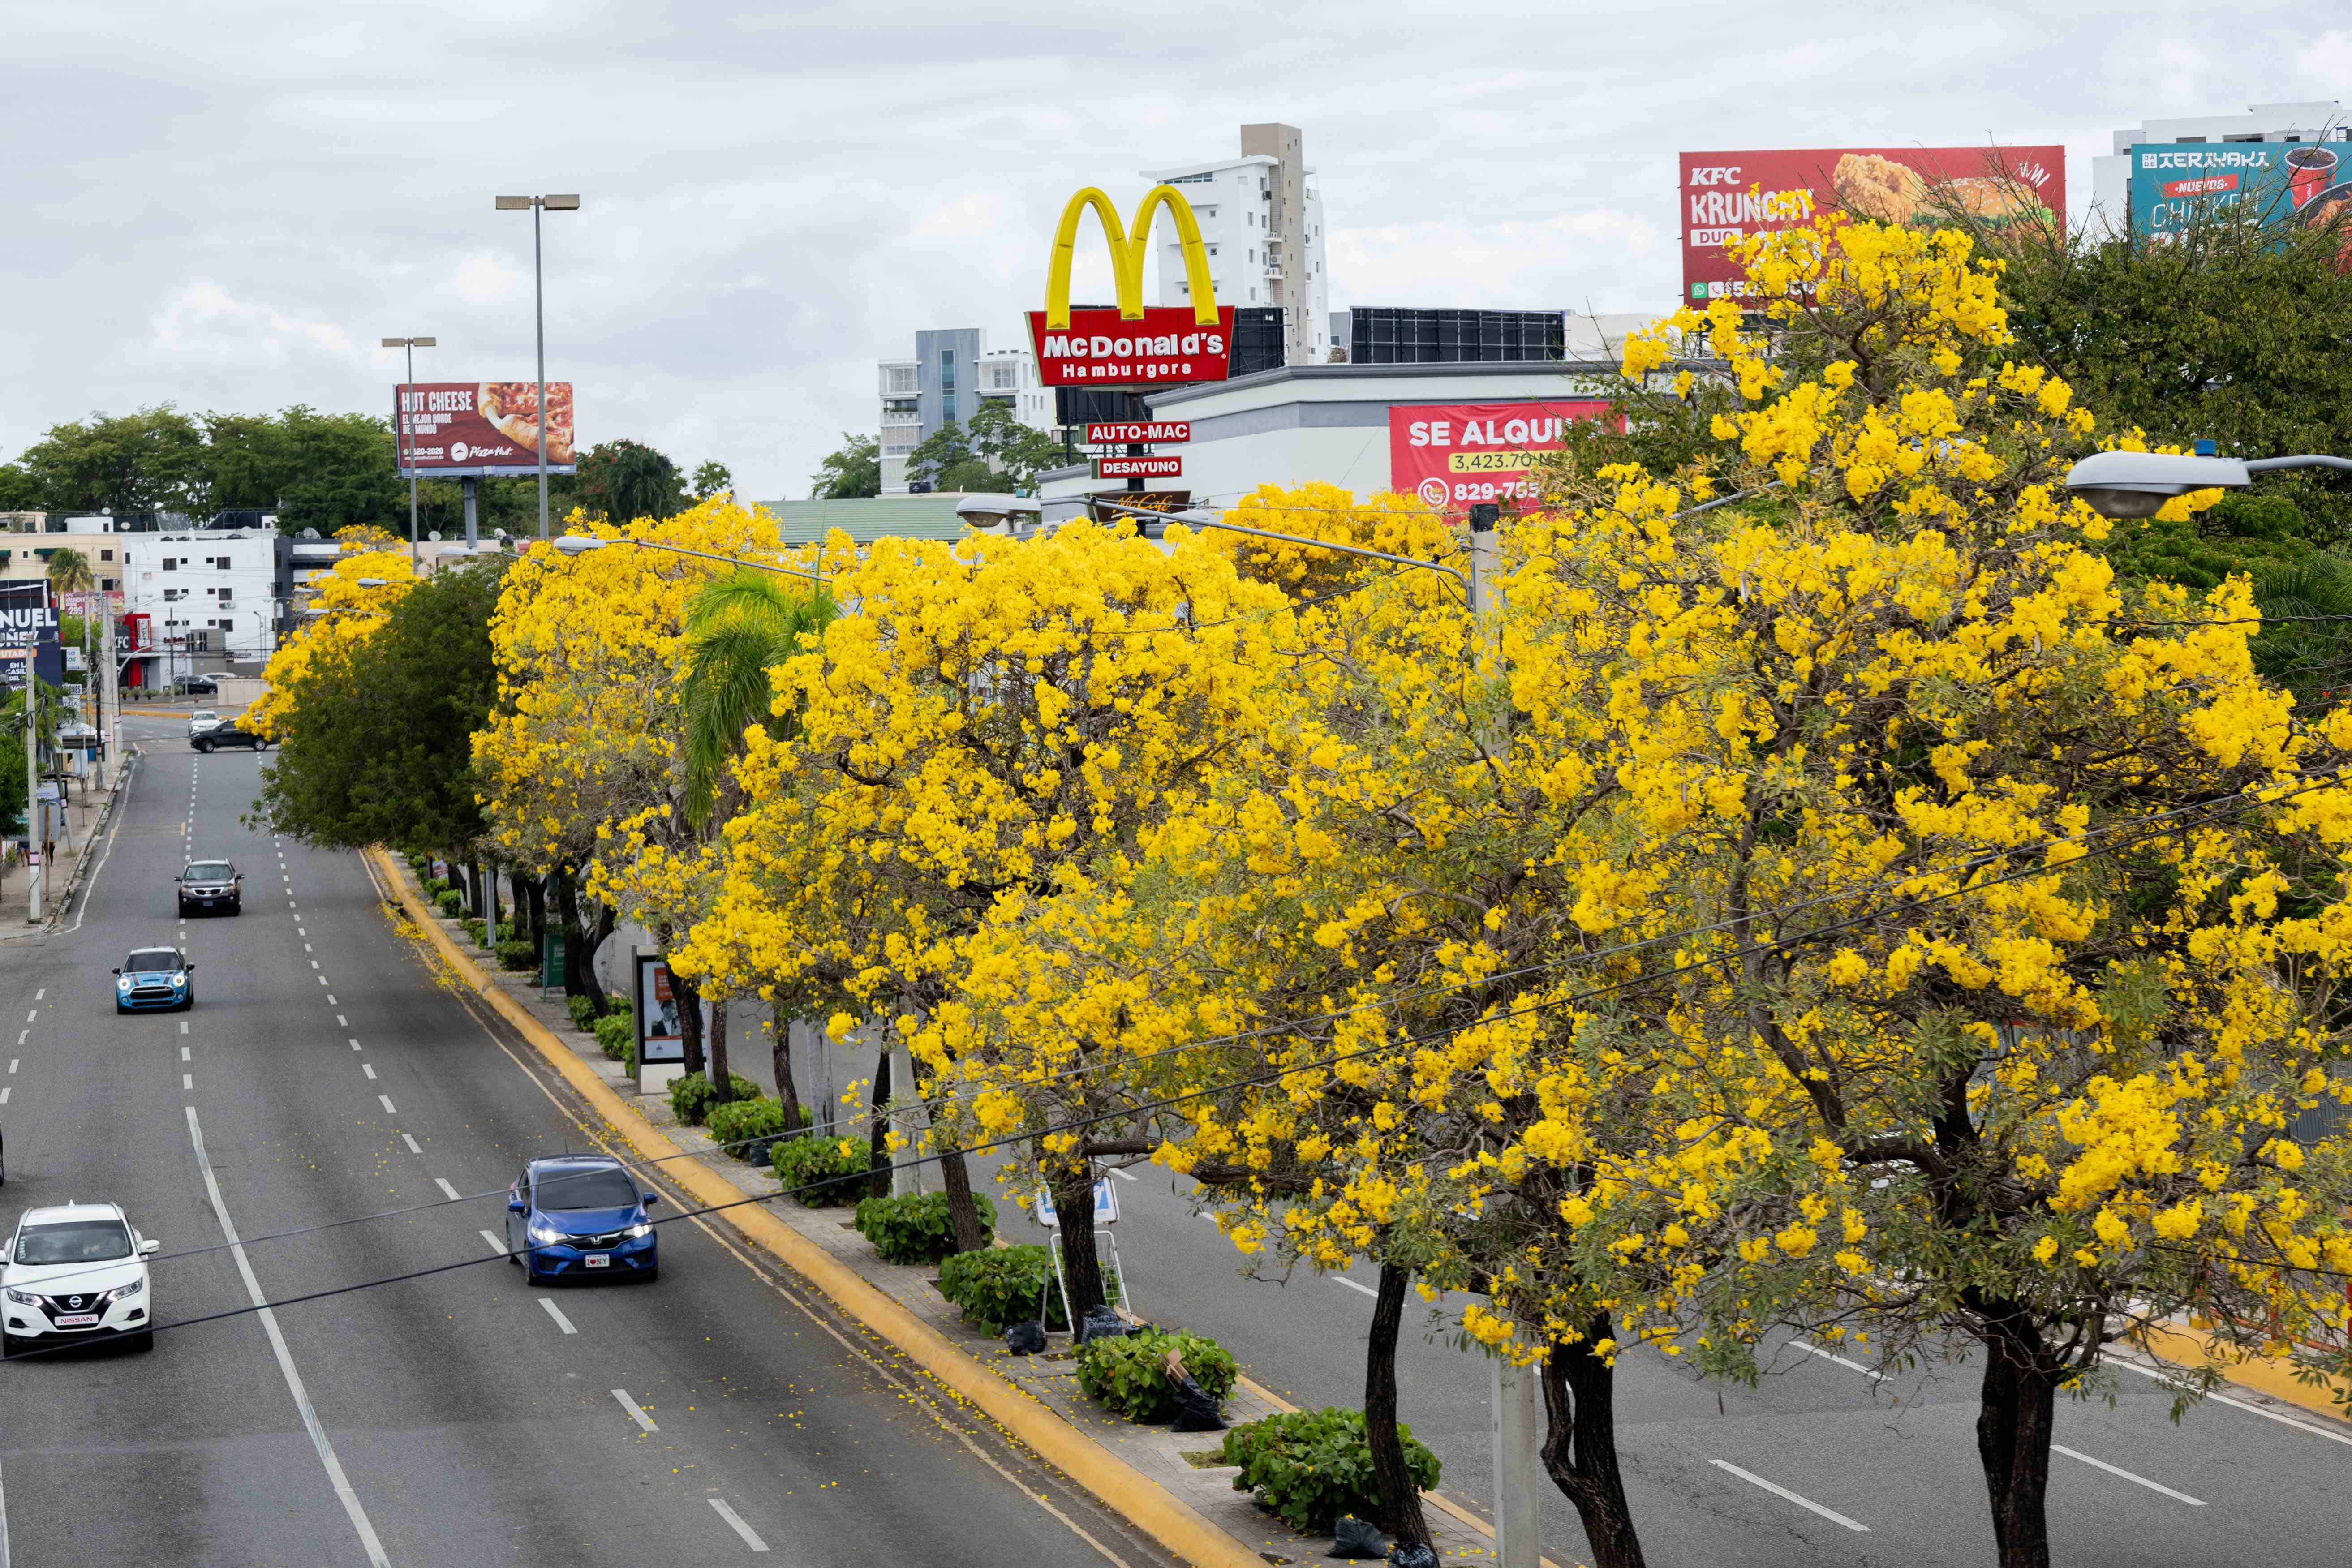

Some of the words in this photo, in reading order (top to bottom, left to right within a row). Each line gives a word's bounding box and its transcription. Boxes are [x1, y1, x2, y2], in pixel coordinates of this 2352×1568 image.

[1689, 167, 1741, 186] KFC
[1043, 333, 1223, 358] McDonald's
[1062, 363, 1191, 378] Hamburgers
[429, 391, 473, 411] CHEESE
[402, 414, 409, 424] EL
[433, 413, 452, 423] BORDE
[415, 424, 437, 434] MUNDO
[1091, 425, 1187, 440] AUTO-MAC
[1409, 421, 1450, 446] SE
[1103, 461, 1178, 473] DESAYUNO
[1454, 453, 1533, 471] 3,423.70
